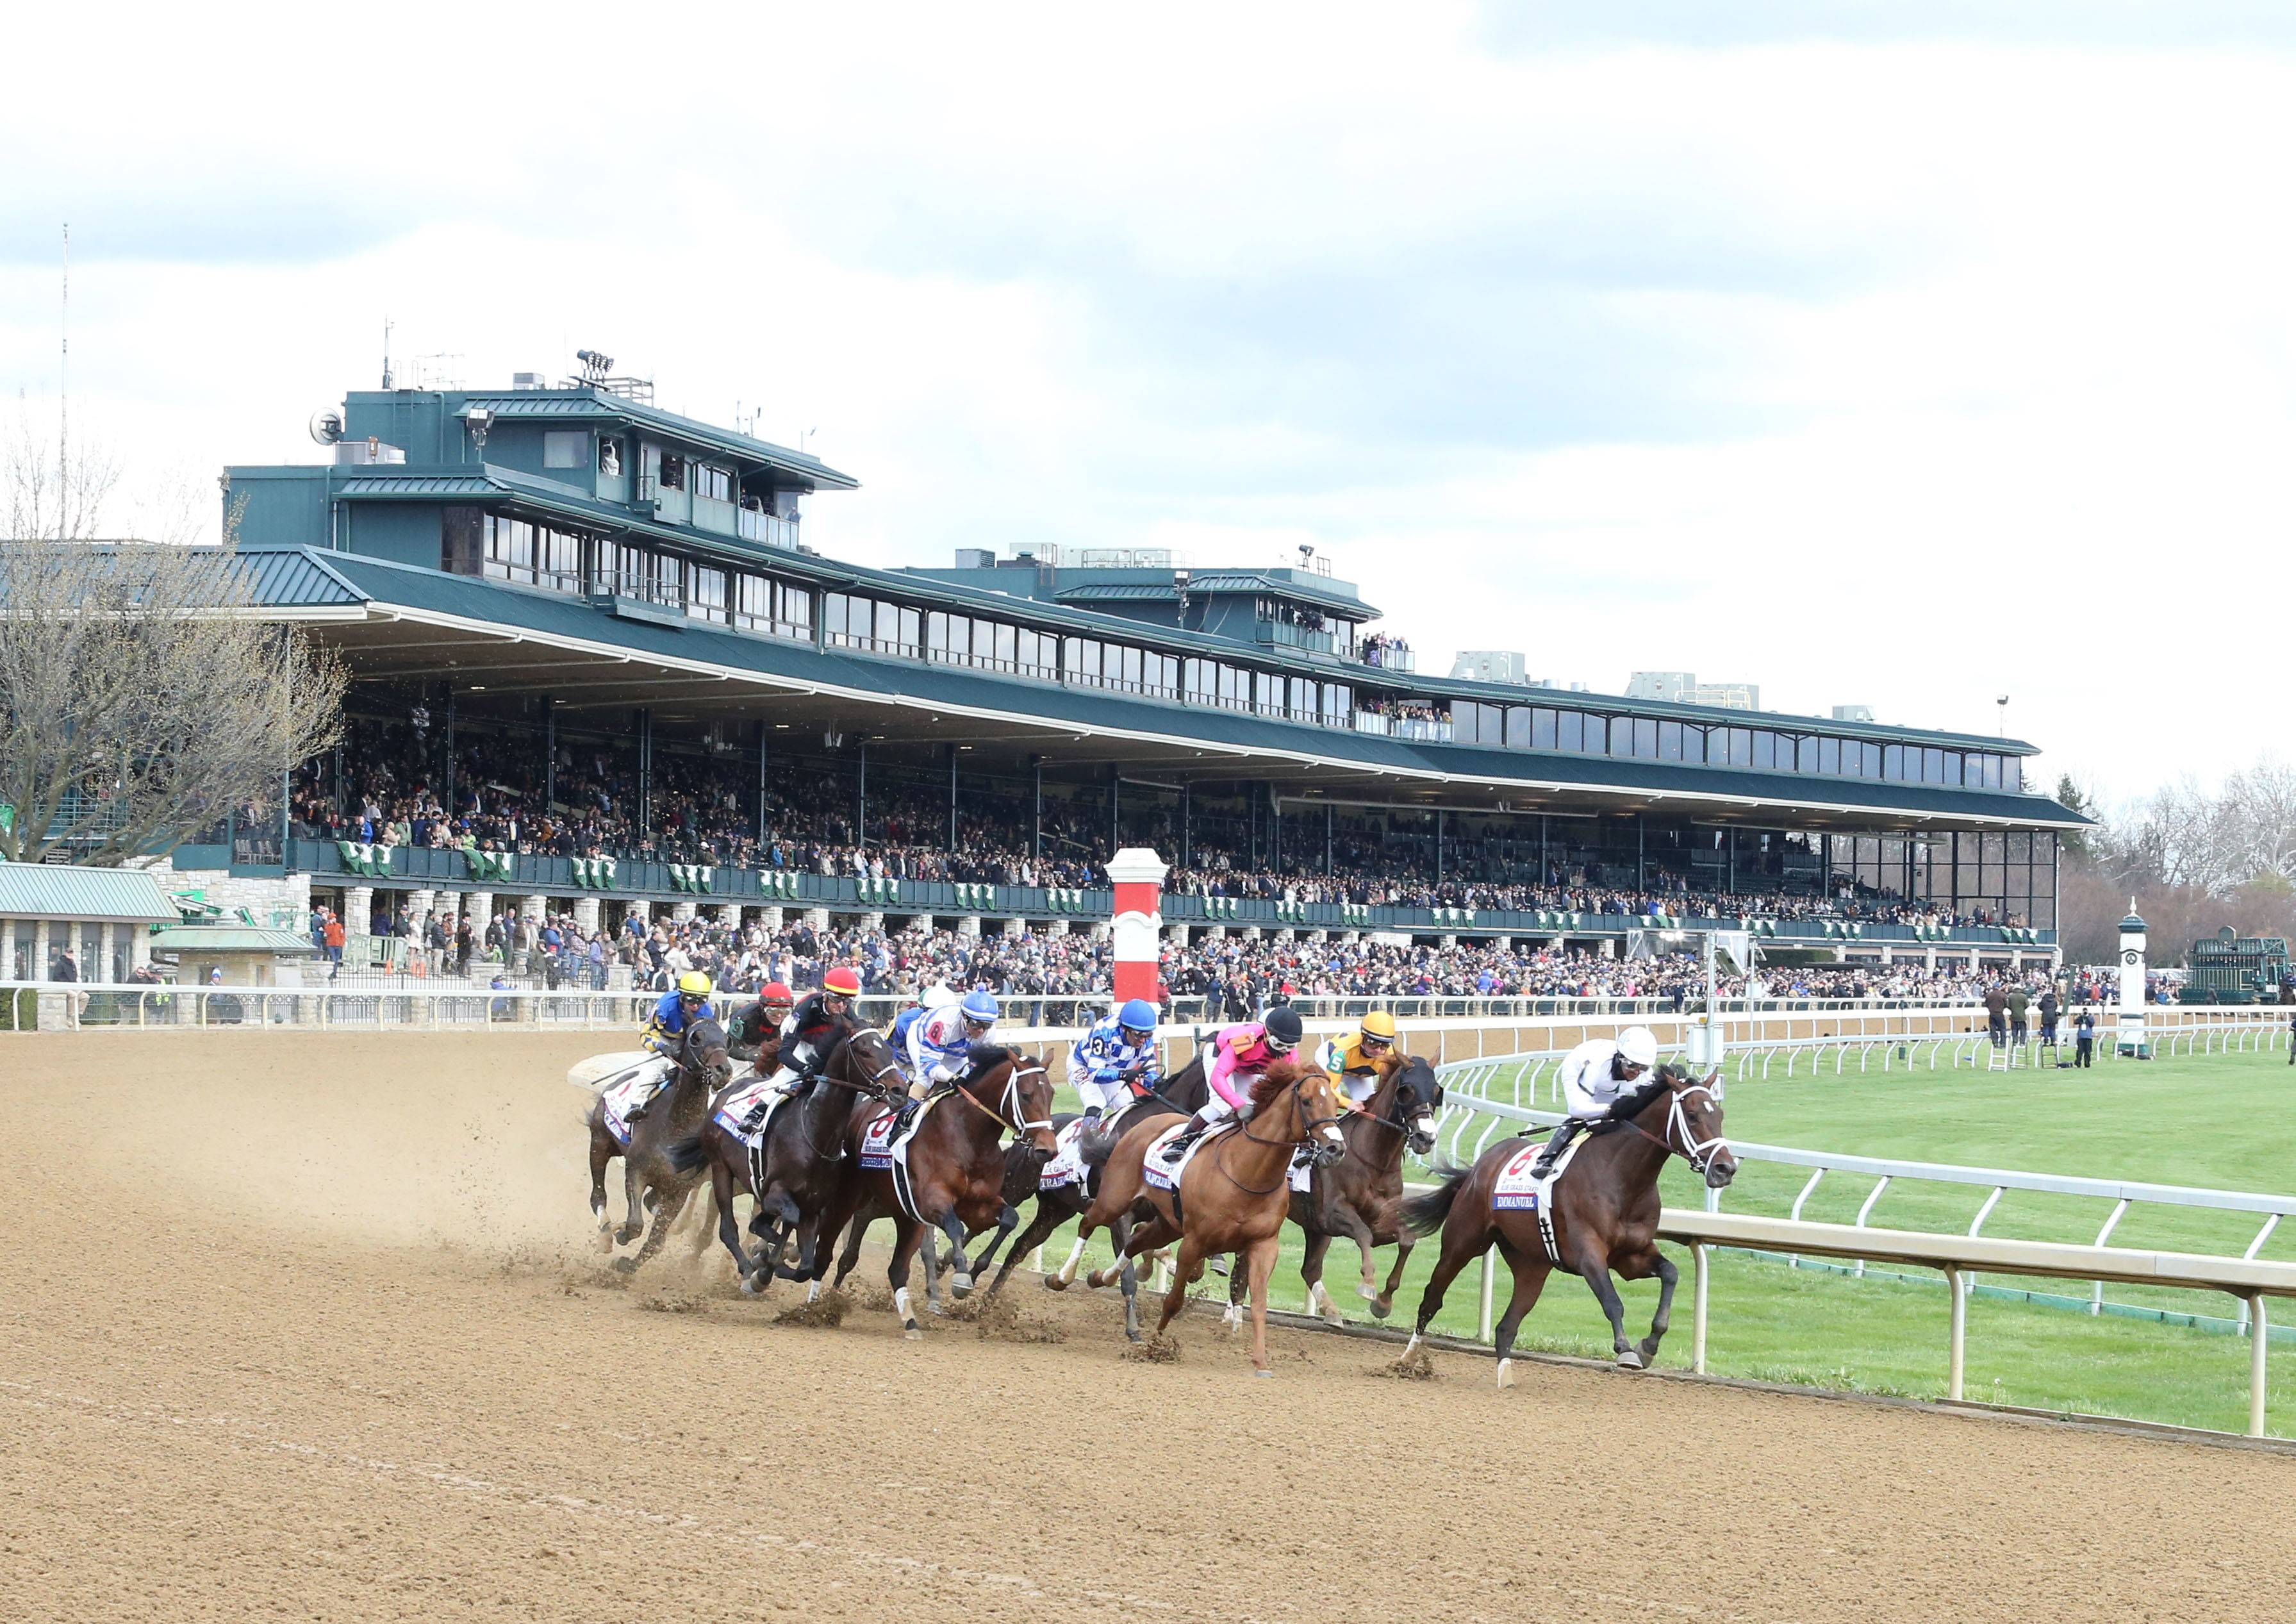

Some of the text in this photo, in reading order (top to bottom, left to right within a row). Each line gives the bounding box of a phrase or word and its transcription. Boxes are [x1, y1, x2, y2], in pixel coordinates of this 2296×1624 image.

[733, 1023, 741, 1032] 9
[930, 1025, 940, 1040] 8
[1093, 1038, 1103, 1056] 3
[1330, 1055, 1342, 1071] 5
[1508, 1144, 1548, 1176] 6
